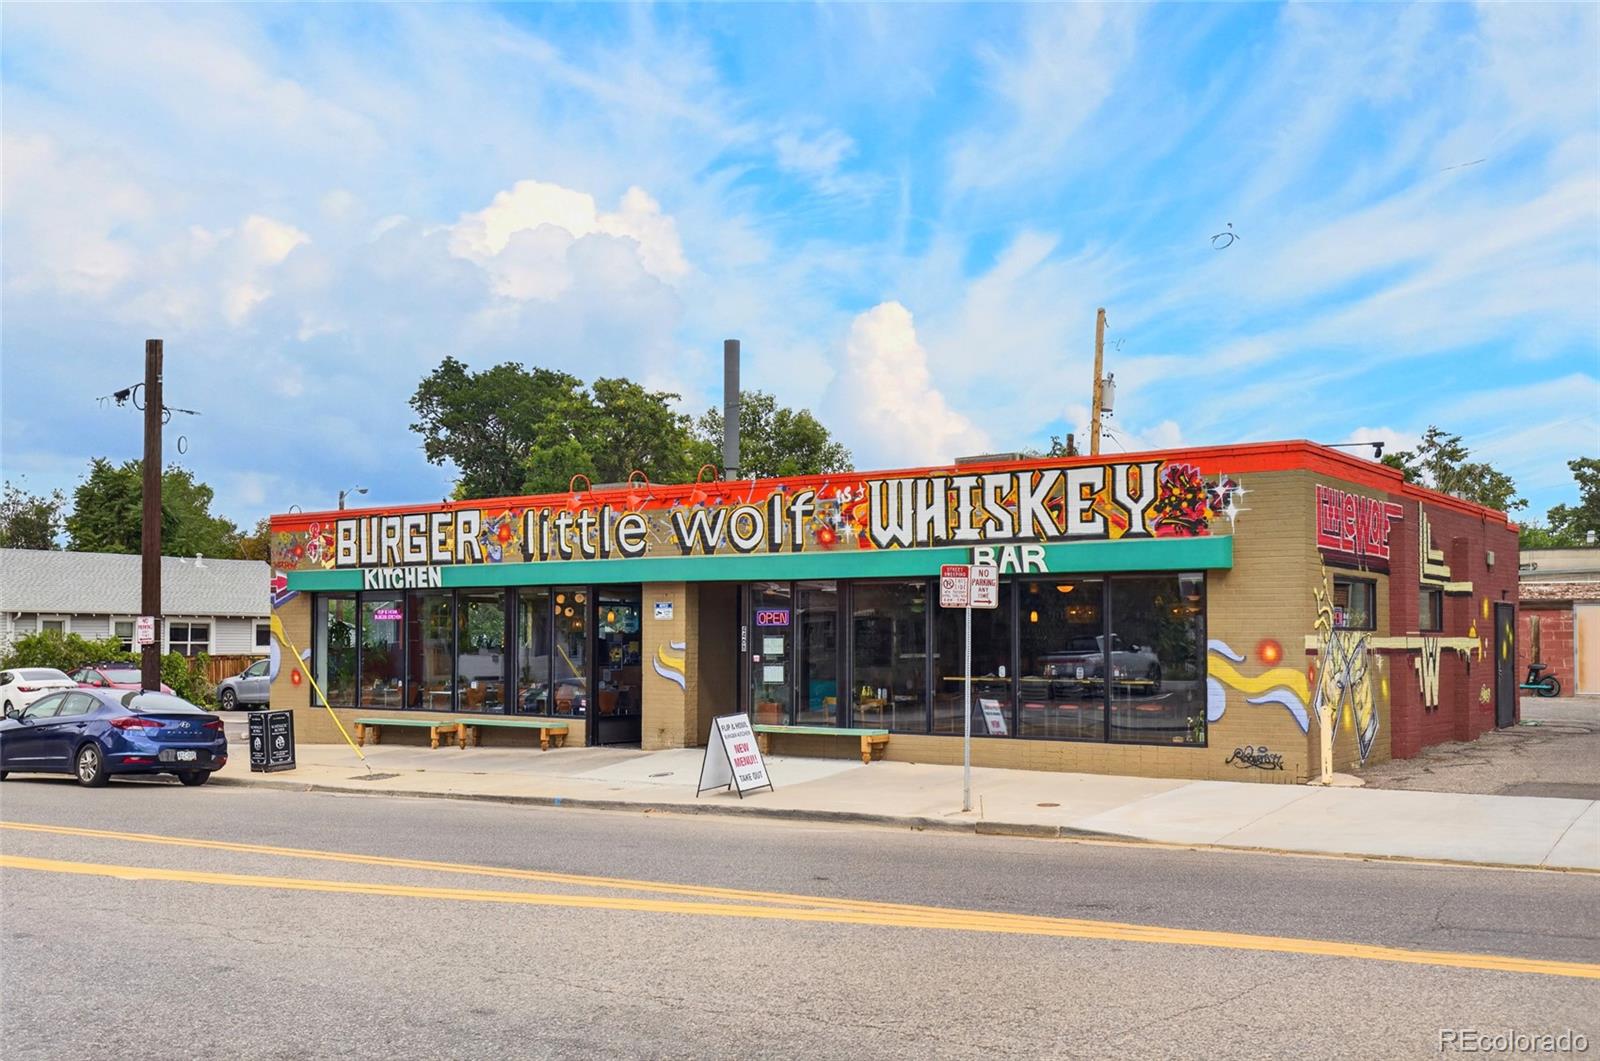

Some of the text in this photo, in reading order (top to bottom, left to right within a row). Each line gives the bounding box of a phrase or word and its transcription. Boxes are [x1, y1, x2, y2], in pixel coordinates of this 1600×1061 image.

[867, 461, 1163, 549] WHISKEY
[522, 490, 816, 562] little wolf
[337, 509, 483, 566] BURGER
[973, 544, 1050, 574] BAR
[364, 566, 442, 590] KITCHEN
[979, 569, 989, 577] NO
[972, 579, 996, 587] PARKING
[758, 612, 787, 624] OPEN
[734, 742, 749, 753] NEW
[739, 770, 763, 782] TAKE OUT
